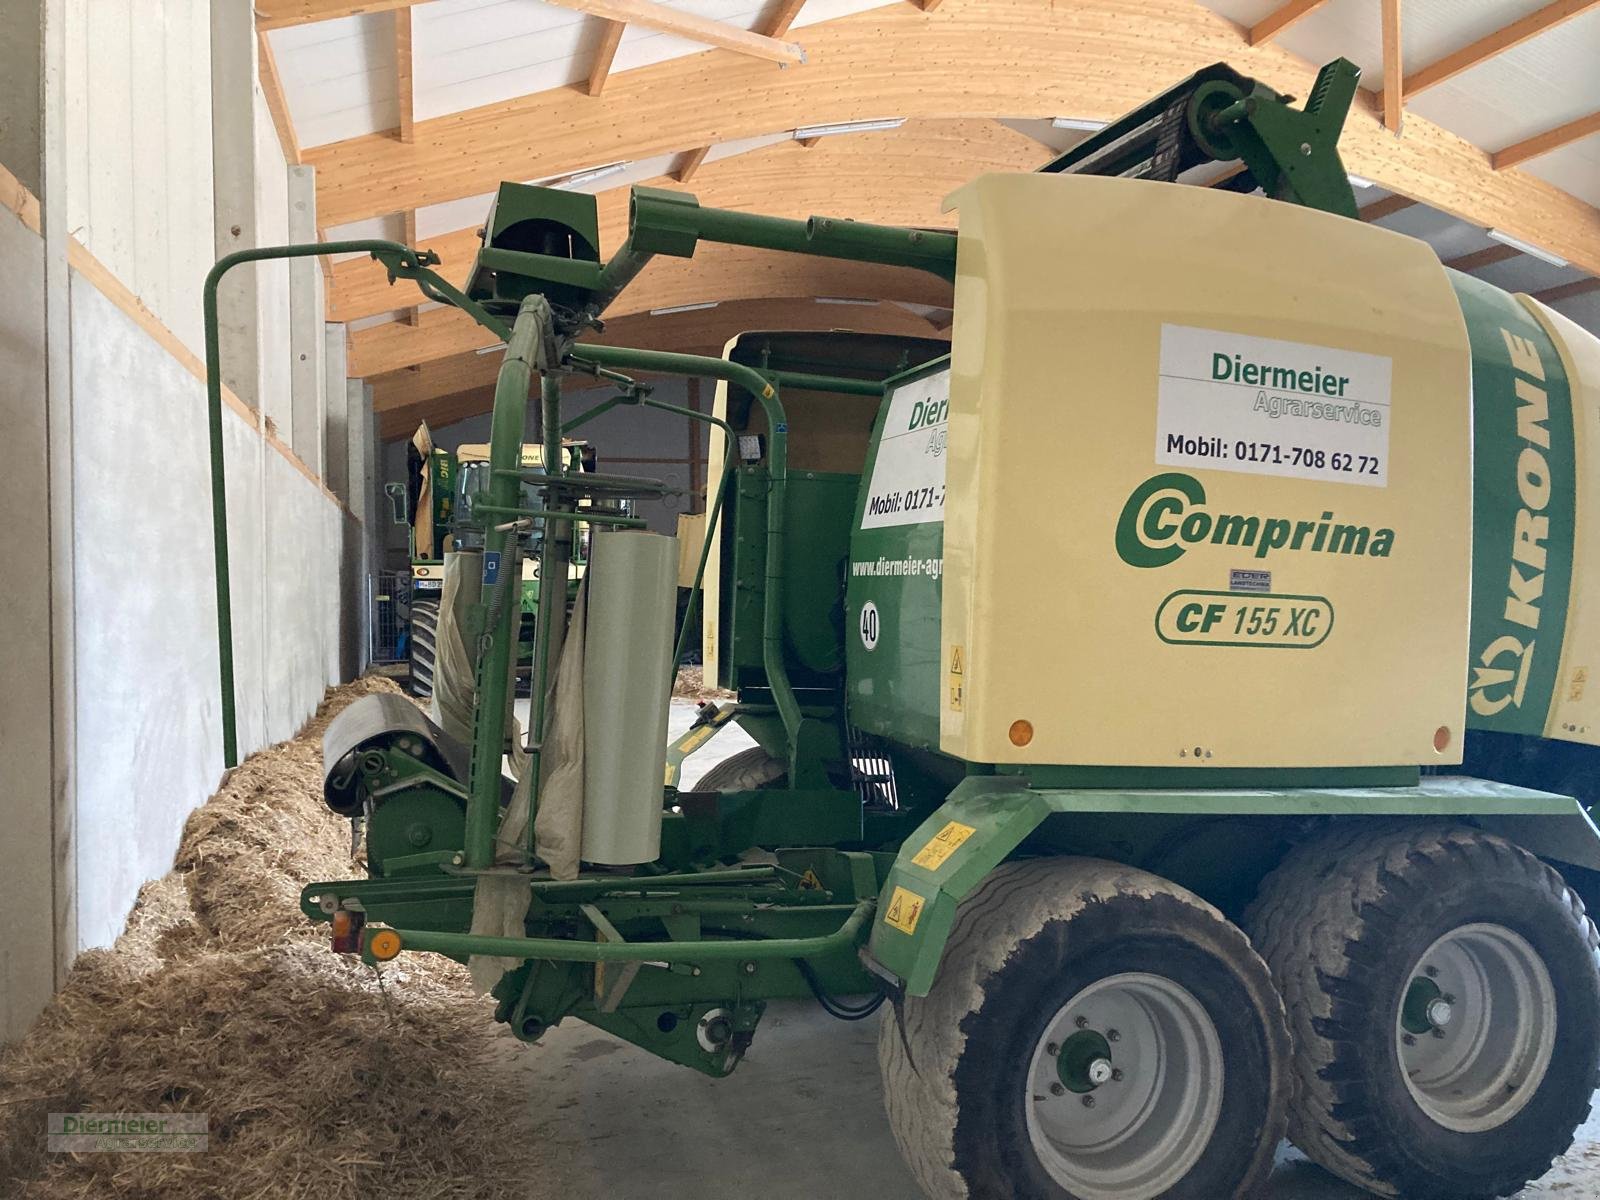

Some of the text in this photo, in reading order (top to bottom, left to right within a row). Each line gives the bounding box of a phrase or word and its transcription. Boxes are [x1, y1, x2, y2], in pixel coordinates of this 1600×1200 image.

[1212, 352, 1349, 397] Diermeier
[1253, 390, 1382, 427] Agrarservice
[924, 427, 948, 457] Ag
[1166, 433, 1379, 475] Mobil: 0171-708 62 72
[1500, 327, 1551, 630] KRONE
[869, 491, 902, 516] Mobil:
[863, 610, 876, 642] 40
[1176, 602, 1320, 637] CF 155 XC
